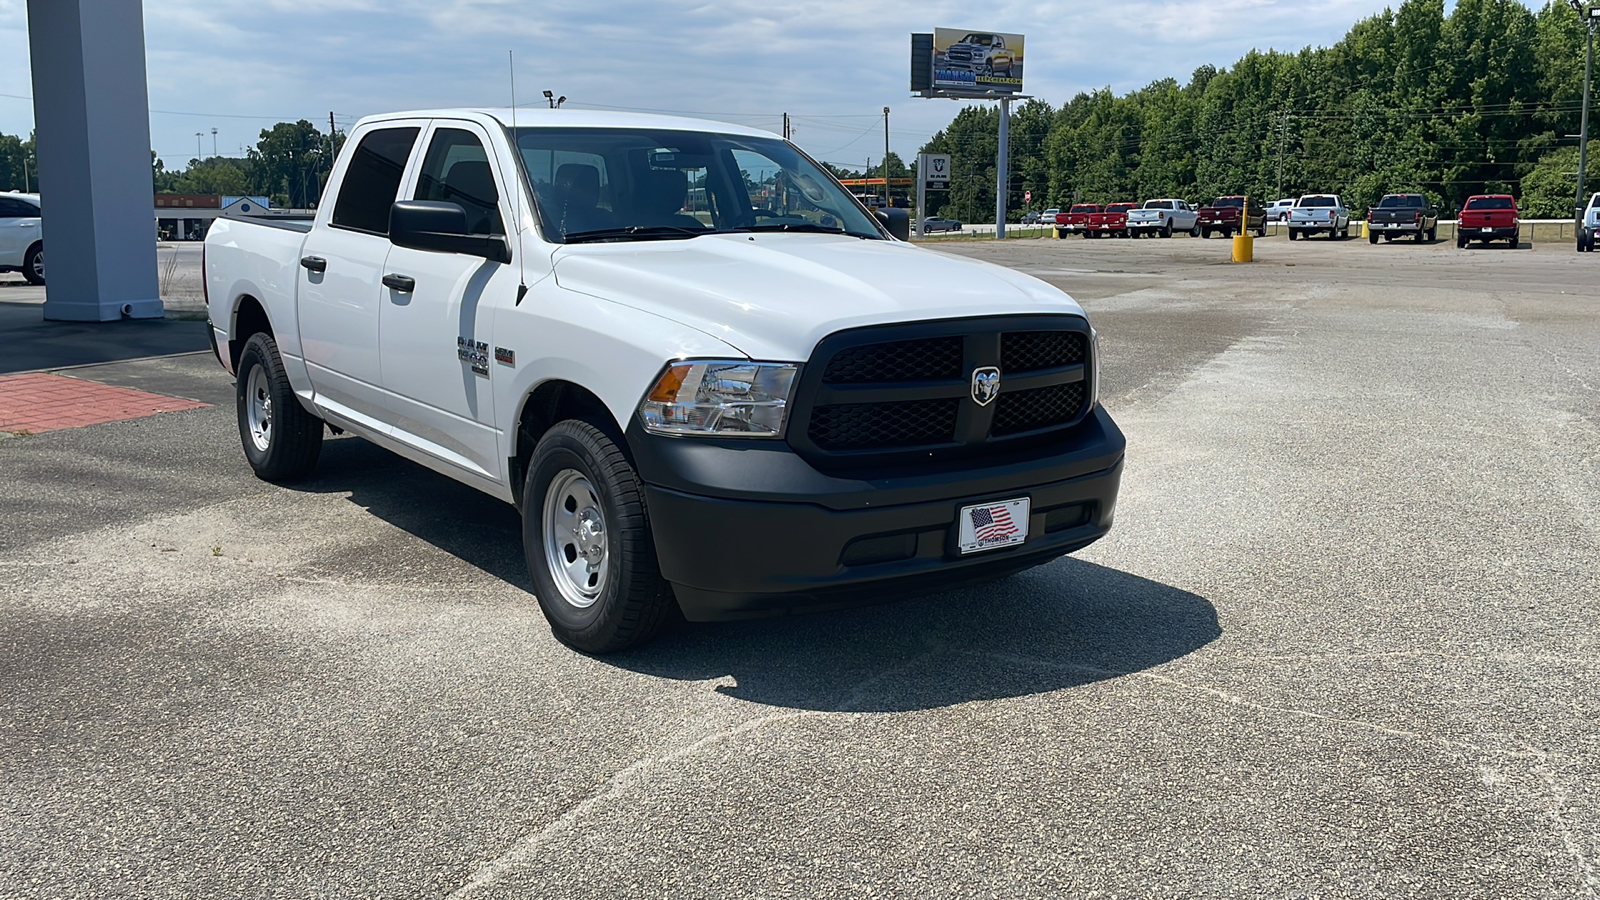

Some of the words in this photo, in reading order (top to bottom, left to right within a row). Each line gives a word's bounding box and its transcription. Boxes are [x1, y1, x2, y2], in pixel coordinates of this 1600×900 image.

[935, 69, 976, 81] THOMSON
[458, 336, 489, 352] RAM
[984, 534, 1010, 544] THOMSON
